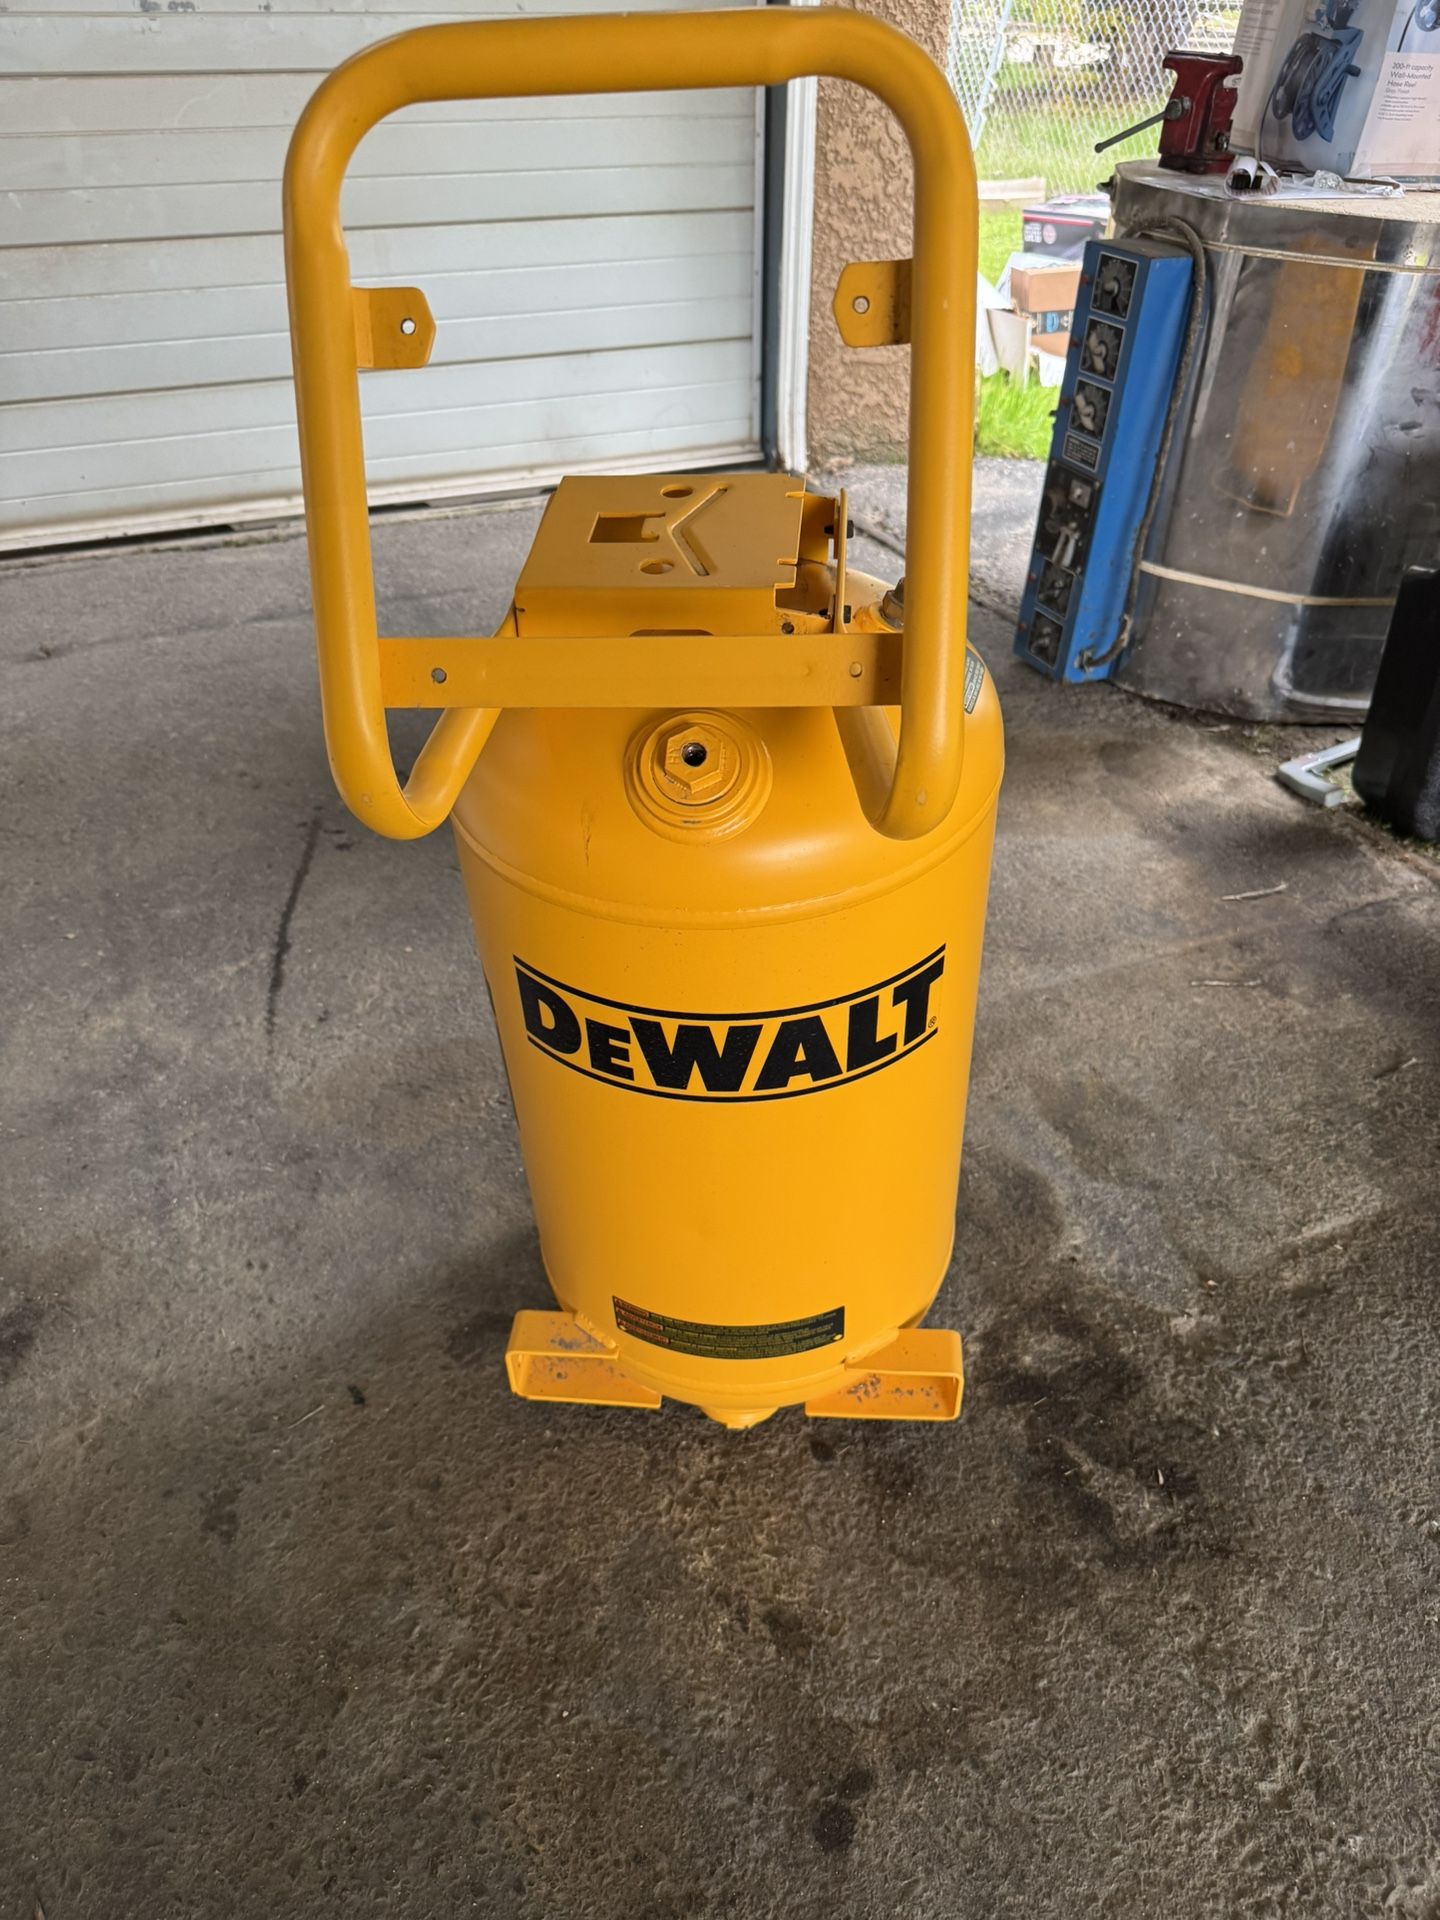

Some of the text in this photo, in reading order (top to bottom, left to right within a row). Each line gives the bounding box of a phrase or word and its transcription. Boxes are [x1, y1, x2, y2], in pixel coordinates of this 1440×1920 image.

[1392, 62, 1433, 72] 200-ft capacity
[1391, 71, 1431, 79] Wall-Mounted
